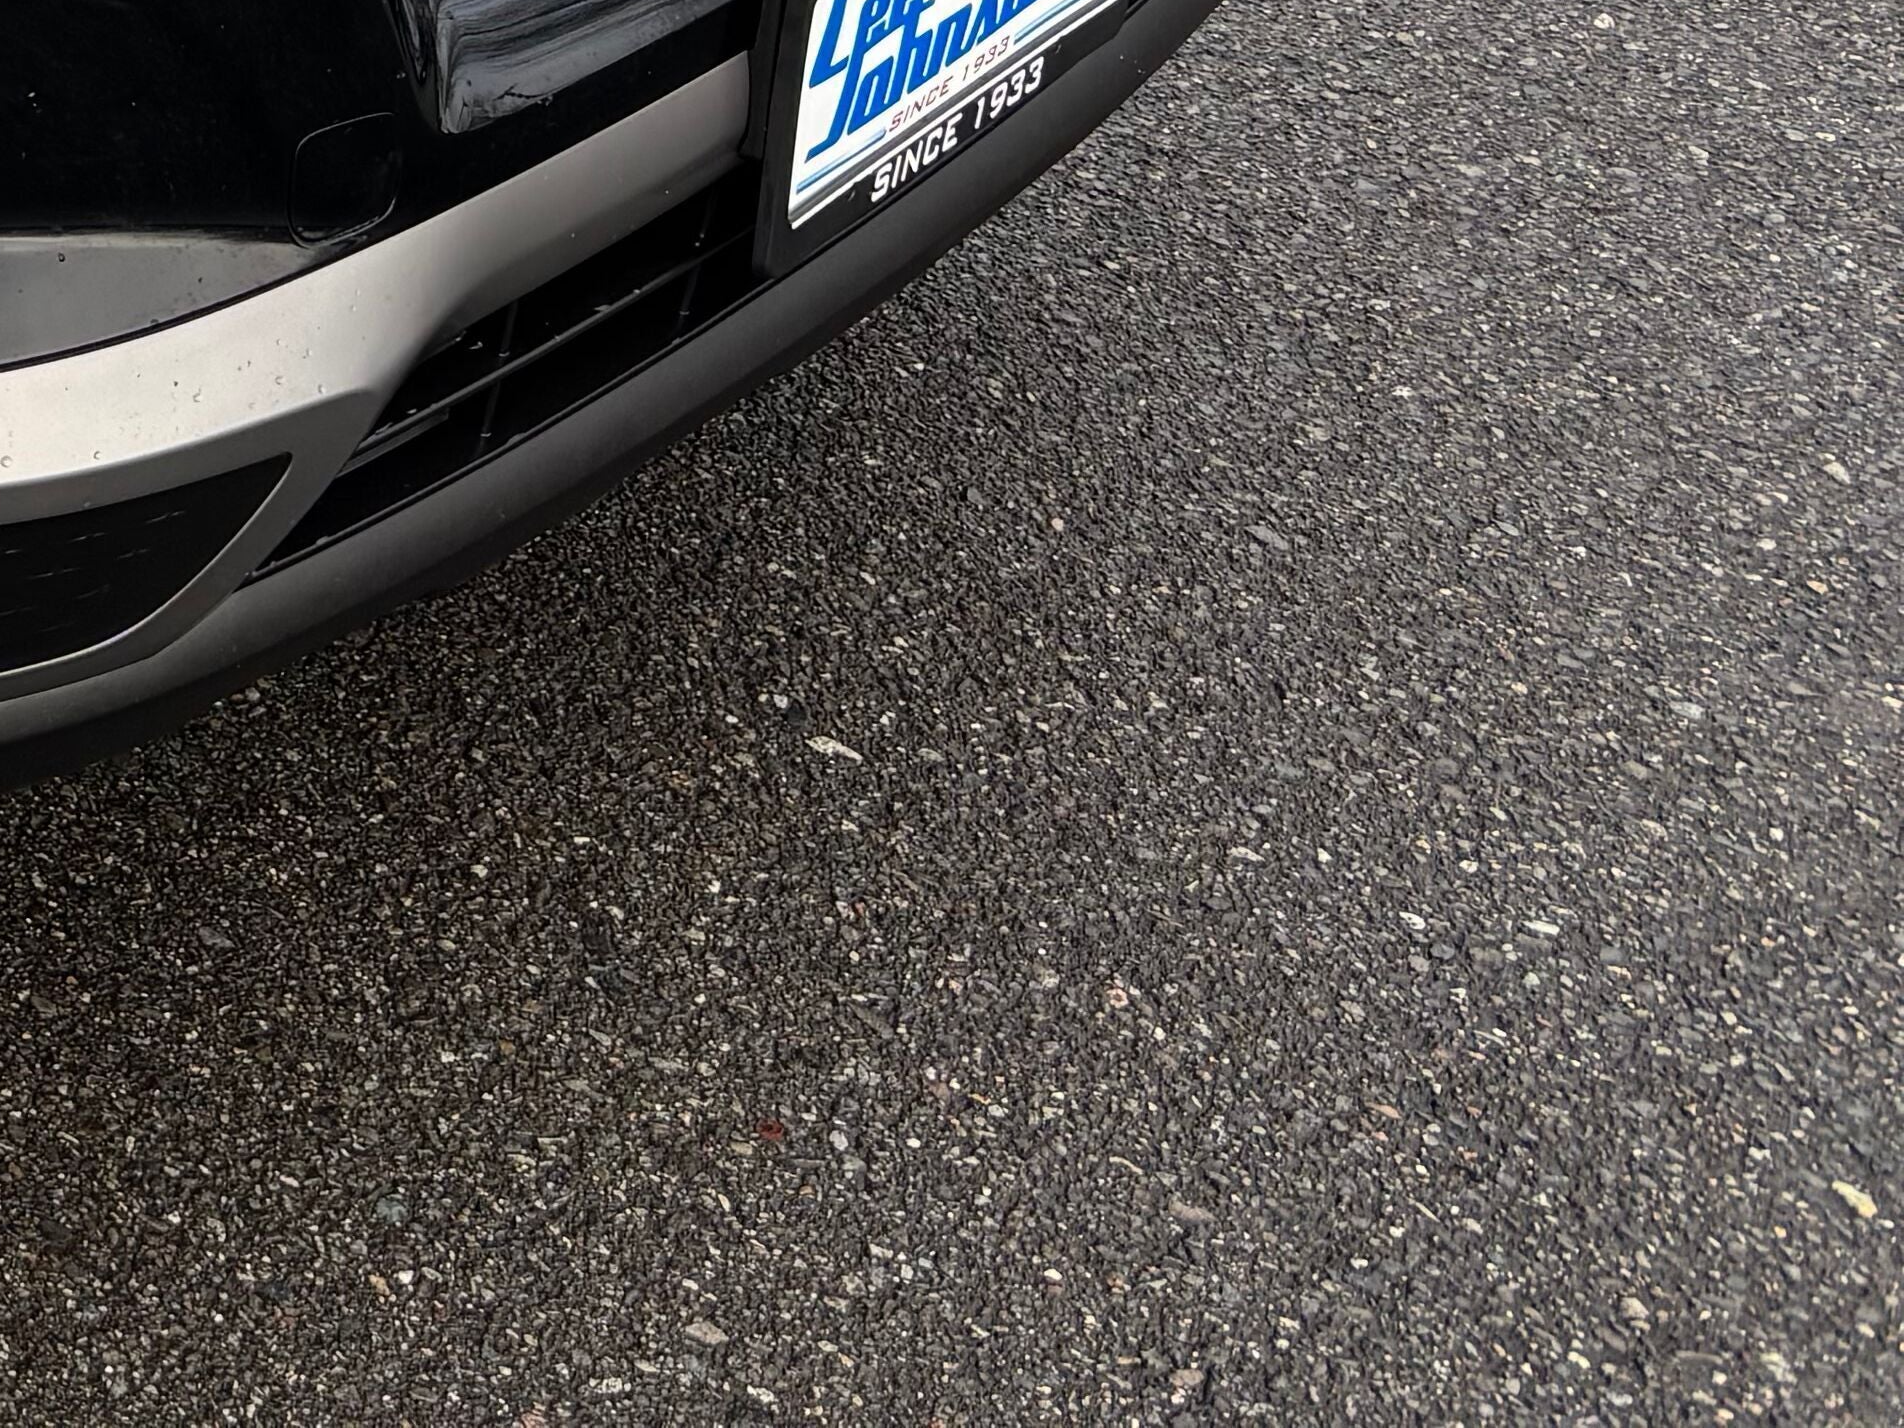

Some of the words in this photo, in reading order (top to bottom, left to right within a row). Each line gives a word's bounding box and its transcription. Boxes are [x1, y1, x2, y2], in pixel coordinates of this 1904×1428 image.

[870, 112, 964, 203] SINCE
[972, 56, 1045, 130] 1933
[888, 75, 955, 133] SINCE
[962, 35, 1011, 82] 1933
